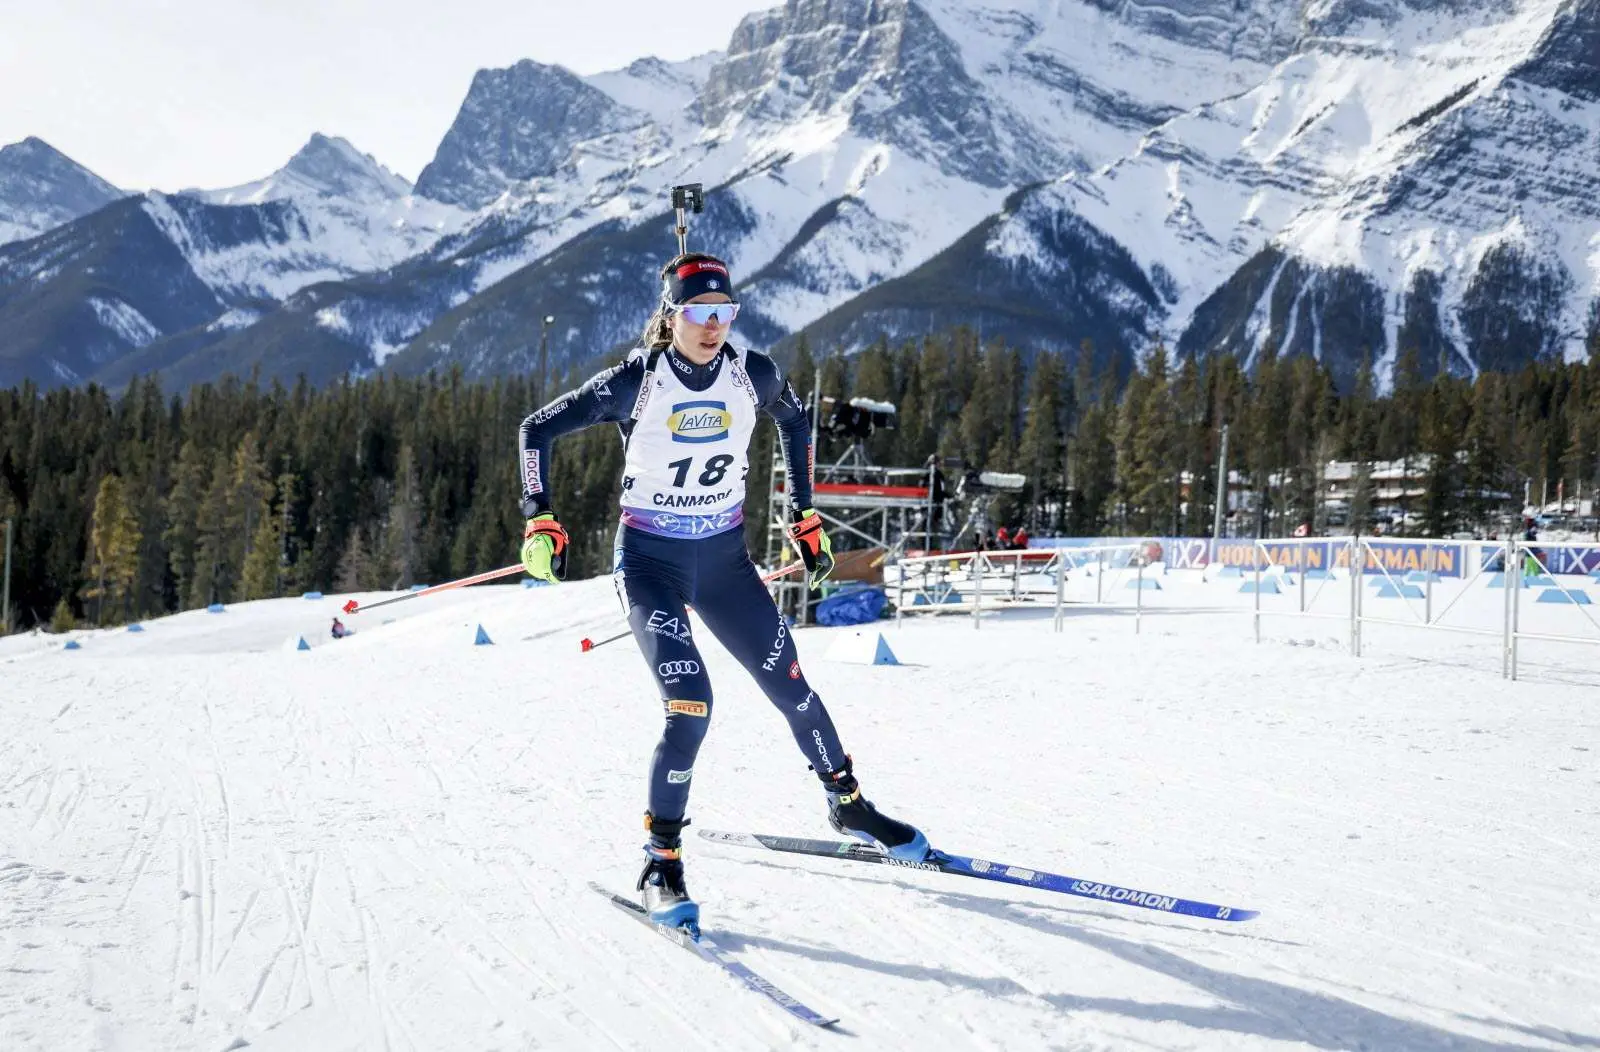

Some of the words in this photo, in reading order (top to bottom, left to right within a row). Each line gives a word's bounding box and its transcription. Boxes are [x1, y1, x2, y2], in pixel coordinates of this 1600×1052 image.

[635, 372, 653, 418] FIOCCHI
[733, 359, 756, 403] FIOCCHI
[526, 450, 541, 493] FIOCCHI
[668, 454, 734, 488] 18
[1171, 540, 1207, 568] iX2
[762, 608, 784, 672] FALCON
[881, 857, 940, 873] SALOMON
[1078, 880, 1178, 911] SALOMON
